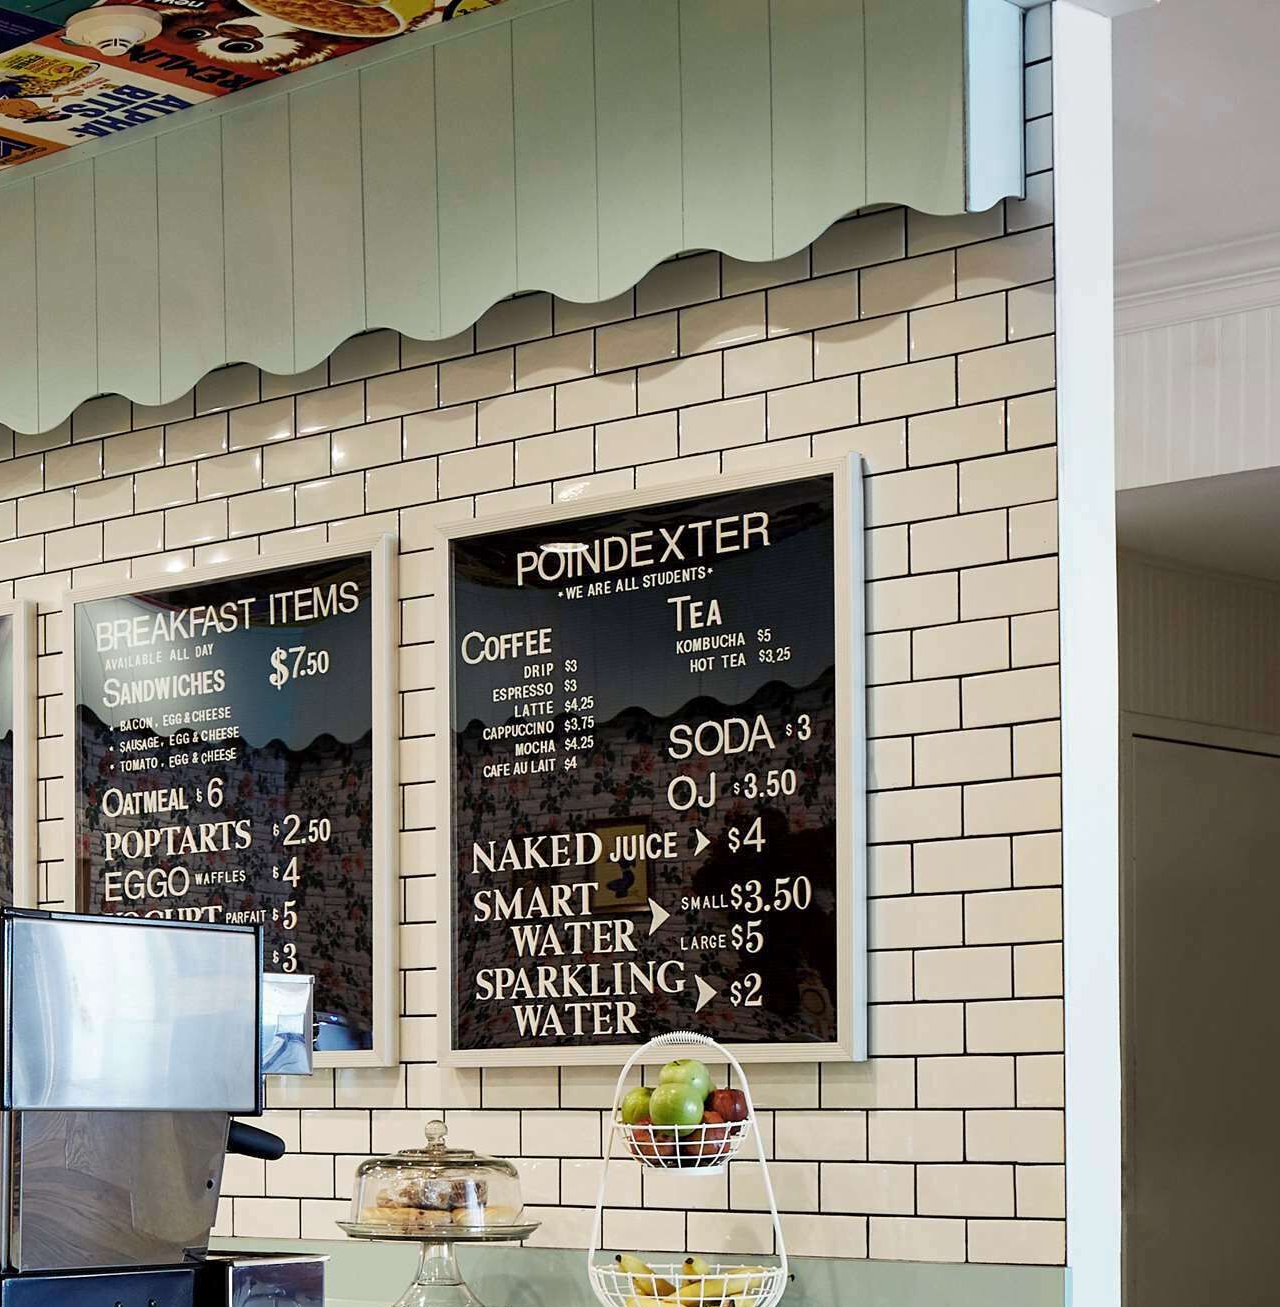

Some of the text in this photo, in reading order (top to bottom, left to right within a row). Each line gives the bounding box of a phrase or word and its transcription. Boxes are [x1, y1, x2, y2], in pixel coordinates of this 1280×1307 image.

[125, 44, 266, 92] REMLIN
[60, 84, 159, 120] BITS
[67, 93, 194, 139] ALPHA-
[517, 511, 771, 586] POINDEXTER
[566, 567, 707, 600] WE ARE ALL STUDENTS
[96, 580, 360, 653] BREAKFAST ITEMS
[667, 595, 722, 632] TEA
[105, 644, 214, 671] AVAILABLE ALL DAY
[461, 627, 553, 665] COFFEE
[676, 628, 771, 655] KOMBUCHA $5
[690, 646, 791, 673] HOT TEA $3.25
[269, 646, 330, 690] $7.50
[523, 659, 578, 679] DRIP $3
[493, 679, 577, 702] ESPRESSO $3
[514, 696, 594, 718] LATTE $4.25
[162, 713, 183, 727] EGG
[191, 706, 232, 723] CHEESE
[483, 716, 595, 742] CAPPUCCINO $3.75
[169, 733, 190, 746] EGG
[192, 731, 200, 743] &
[200, 726, 240, 742] CHEESE
[515, 736, 594, 757] MOCHA $4.25
[667, 713, 812, 761] SODA $3
[169, 754, 189, 767] EGG
[191, 752, 199, 764] &
[201, 747, 237, 765] CHEESE
[483, 756, 578, 779] CAFE AU LAIT $4
[102, 787, 189, 818] OATMEAL
[667, 768, 798, 811] OJ $3.50
[104, 814, 331, 862] POPTARTS $2.50
[472, 816, 767, 875] NAKED JUICE $4
[105, 865, 190, 902] EGGO
[194, 870, 247, 886] WAFFLES
[473, 875, 812, 924] SMART SMALL $3.50
[225, 909, 266, 924] PARFAIT
[511, 918, 765, 958] WATER LARGE $5
[475, 960, 764, 1008] SPARKLING $2
[513, 1001, 640, 1038] WATER
